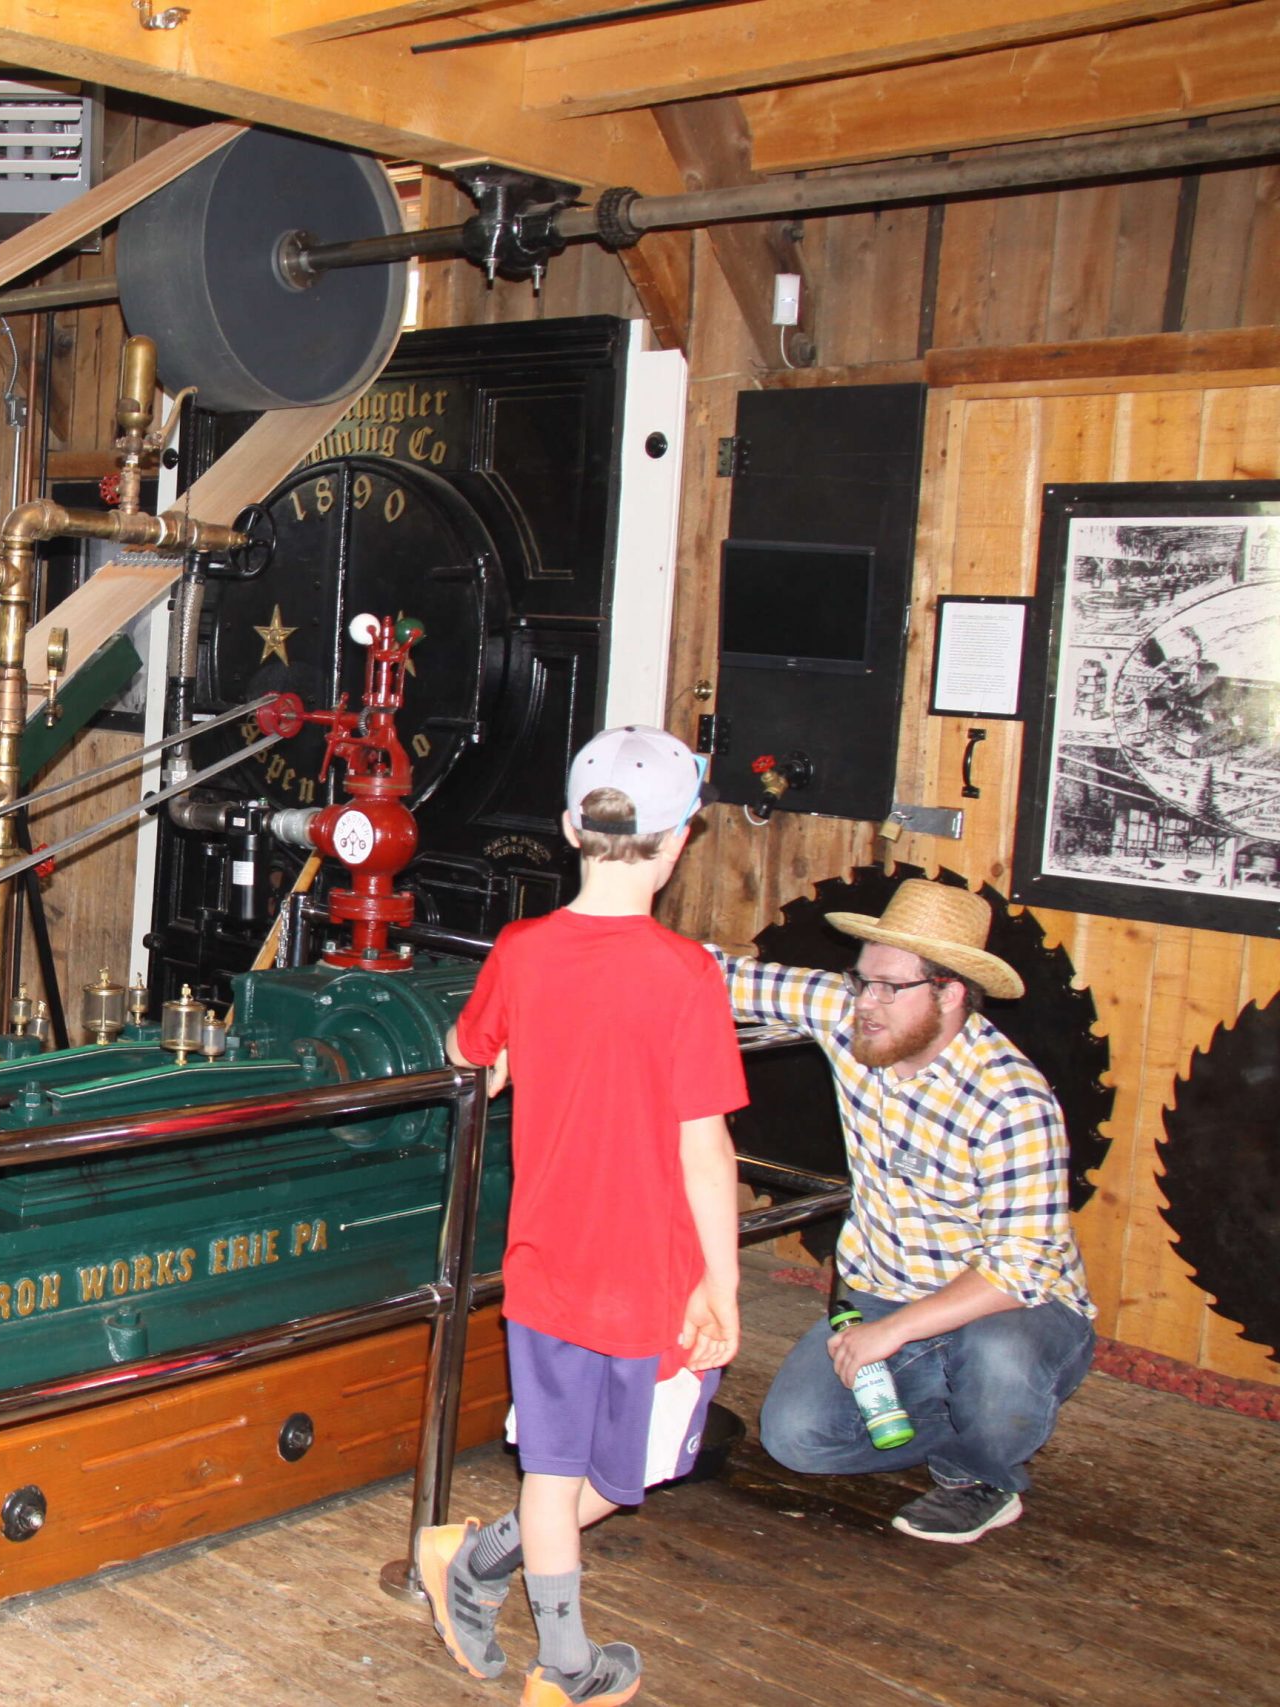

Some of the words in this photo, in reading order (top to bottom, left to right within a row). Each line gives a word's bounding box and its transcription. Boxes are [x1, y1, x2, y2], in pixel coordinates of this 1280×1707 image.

[344, 384, 448, 424] uggler
[409, 426, 447, 465] Co
[289, 474, 407, 523] 1890
[77, 1248, 197, 1301] WORKS
[209, 1229, 280, 1275] ERIE
[291, 1218, 328, 1257] PA
